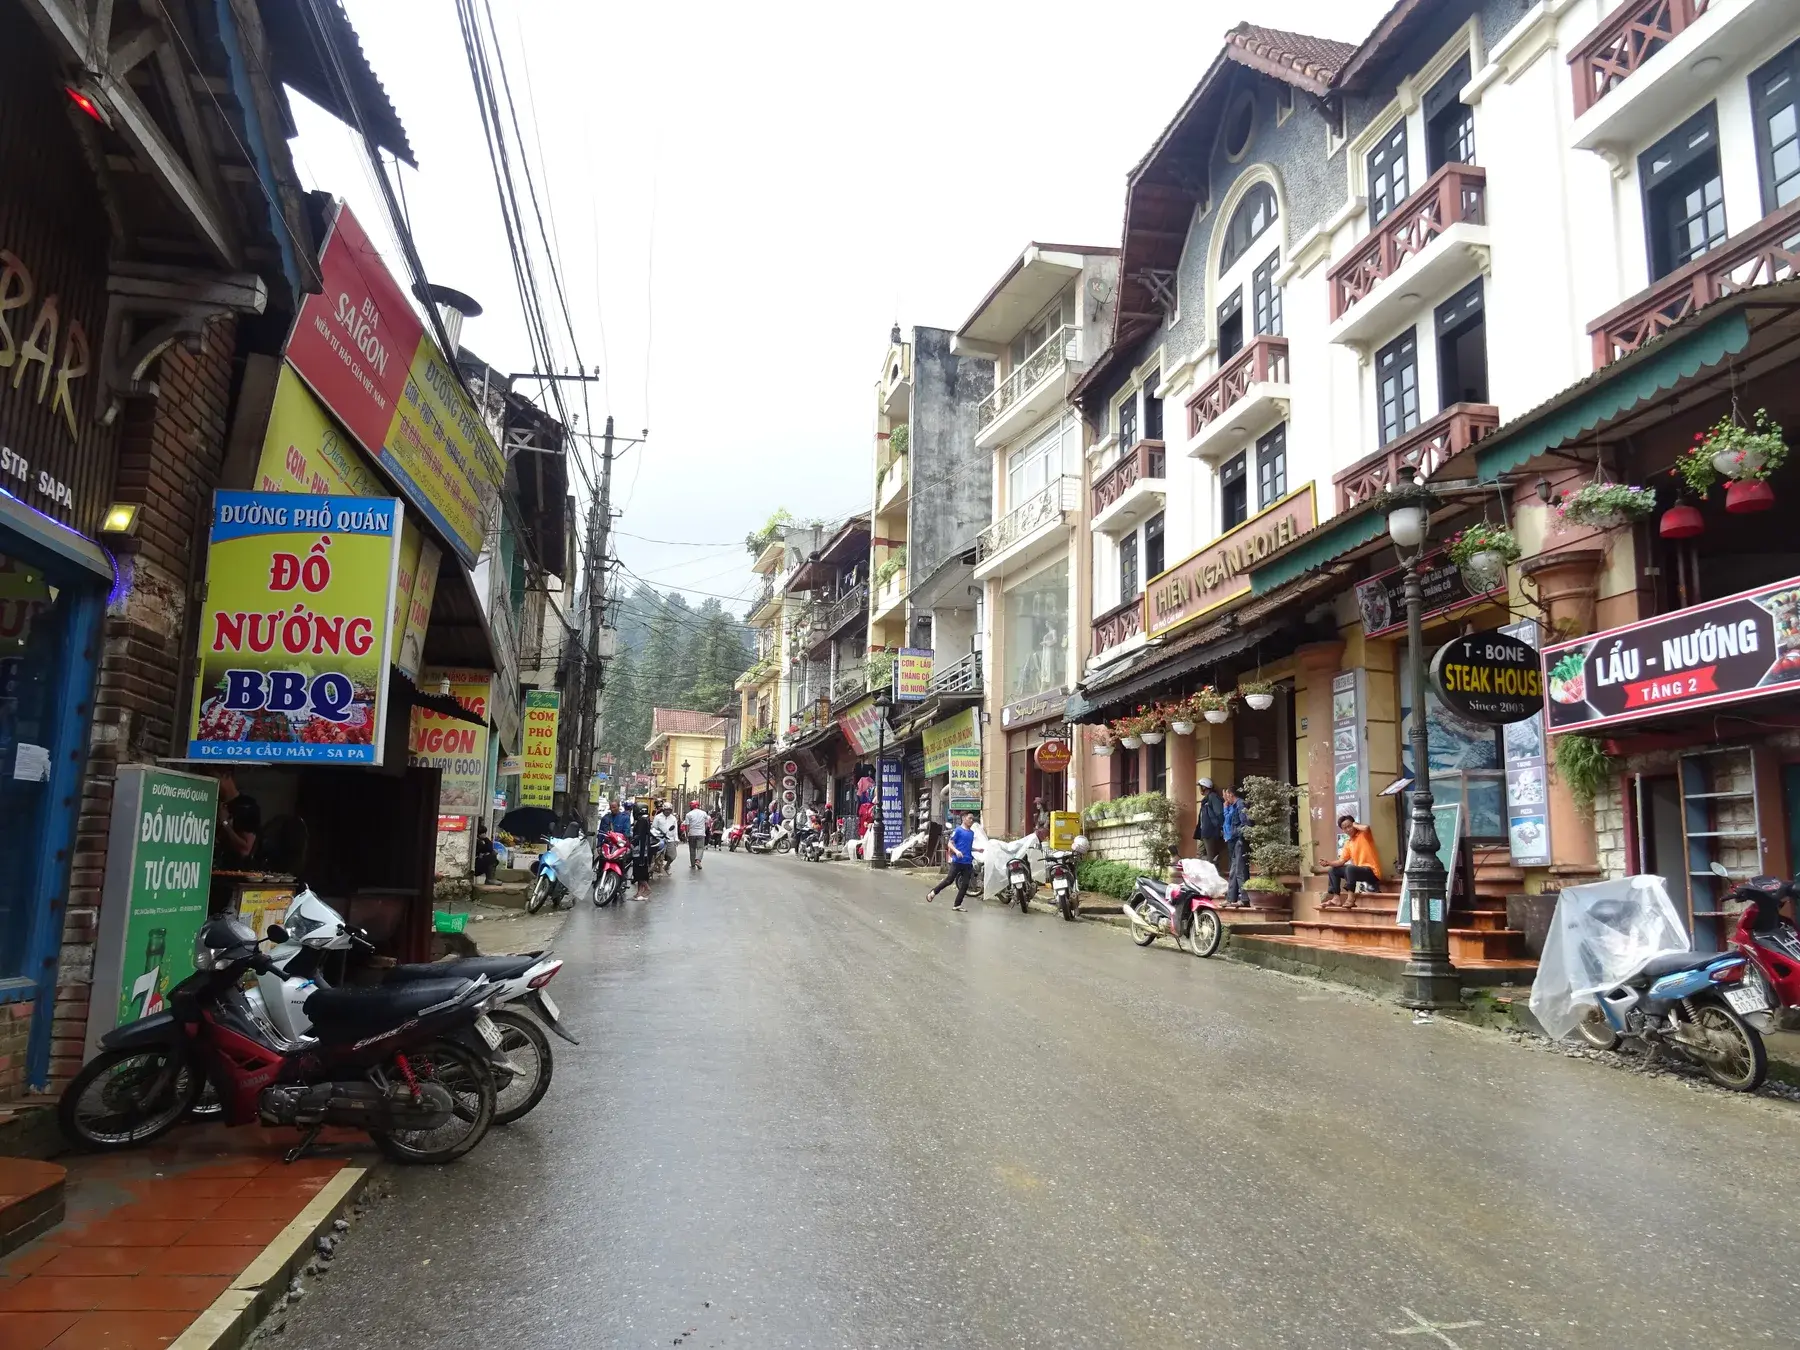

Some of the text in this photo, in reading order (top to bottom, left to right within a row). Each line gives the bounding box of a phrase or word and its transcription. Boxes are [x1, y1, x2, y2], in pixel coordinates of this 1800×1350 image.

[361, 297, 379, 330] BIA
[0, 248, 90, 443] BAR
[333, 292, 389, 376] SAIGON
[338, 346, 352, 366] HÀO
[351, 361, 363, 382] CỦA
[362, 376, 374, 395] VIỆT
[372, 391, 386, 410] NAM
[1, 446, 73, 510] STR SAPA
[285, 445, 308, 485] CƠM
[220, 500, 390, 533] ĐƯỜNG PHỐ QUÁN
[268, 534, 333, 593] ĐỒ
[212, 604, 375, 656] NƯỚNG
[1463, 643, 1472, 658] T
[1485, 644, 1525, 662] BONE
[1595, 639, 1640, 687] LẨU
[1662, 619, 1759, 672] NƯỚNG
[1445, 663, 1492, 693] STEAK
[1641, 678, 1698, 702] TẦNG 2
[223, 669, 354, 722] BBQ
[1469, 700, 1497, 713] Since
[528, 725, 553, 738] PHỞ
[529, 710, 555, 722] CƠM
[227, 746, 251, 755] 024
[256, 741, 283, 756] CẦU
[286, 744, 314, 757] MÂY
[327, 749, 345, 758] SA
[348, 749, 365, 759] PA
[417, 728, 477, 754] NGON
[454, 758, 482, 776] GOOD
[951, 770, 979, 779] SA PA BBQ
[152, 783, 208, 803] ĐƯỜNG PHỐ QUÁN
[141, 804, 210, 846] ĐỒ NƯỚNG
[145, 856, 201, 899] TỰ CHỌN
